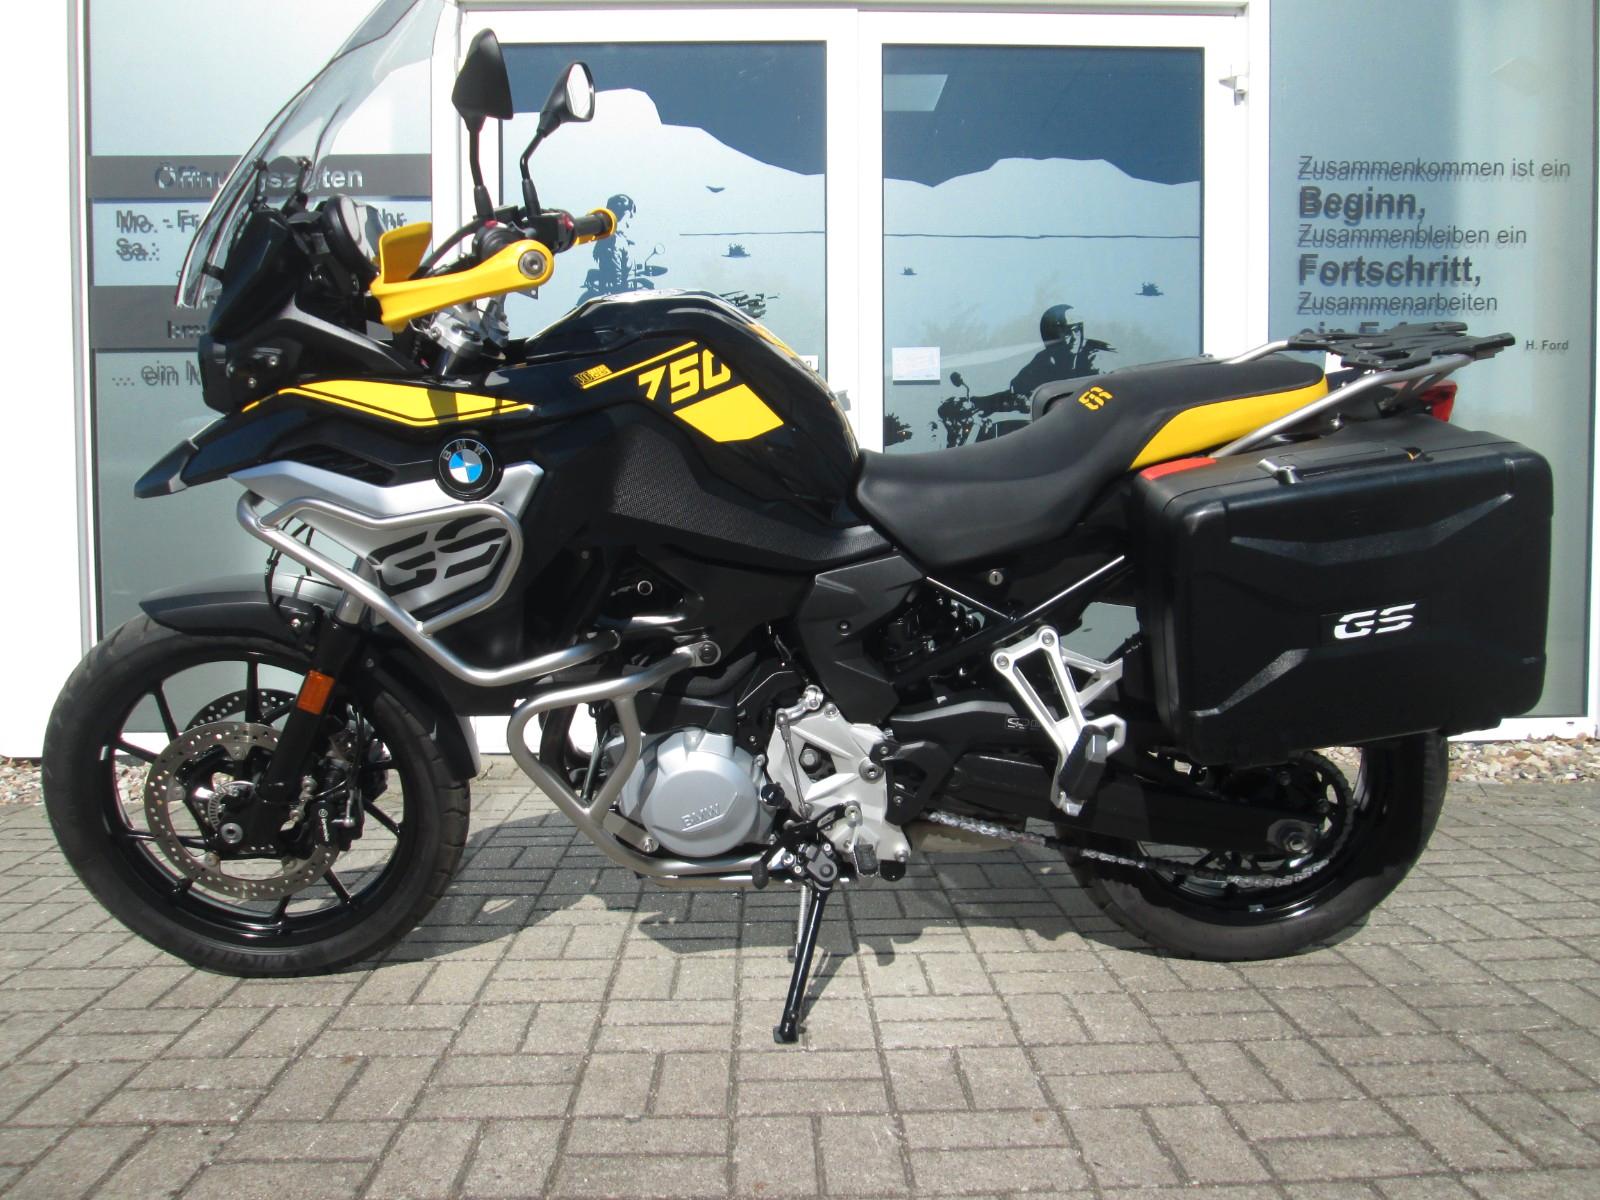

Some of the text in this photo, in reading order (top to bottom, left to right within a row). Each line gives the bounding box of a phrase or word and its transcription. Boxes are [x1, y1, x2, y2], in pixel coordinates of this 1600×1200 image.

[1298, 155, 1571, 180] Zusammenkommen ist ein
[1299, 185, 1426, 226] Beginn,
[1298, 223, 1527, 248] Zusammenbleiben ein
[1299, 253, 1481, 287] Fortschritt,
[1298, 291, 1498, 315] Zusammenarbeiten
[1526, 339, 1569, 350] H. Ford
[141, 360, 179, 386] ein
[638, 349, 731, 404] 750
[441, 439, 487, 461] BMW
[1334, 603, 1416, 639] GS
[681, 803, 721, 828] BMW
